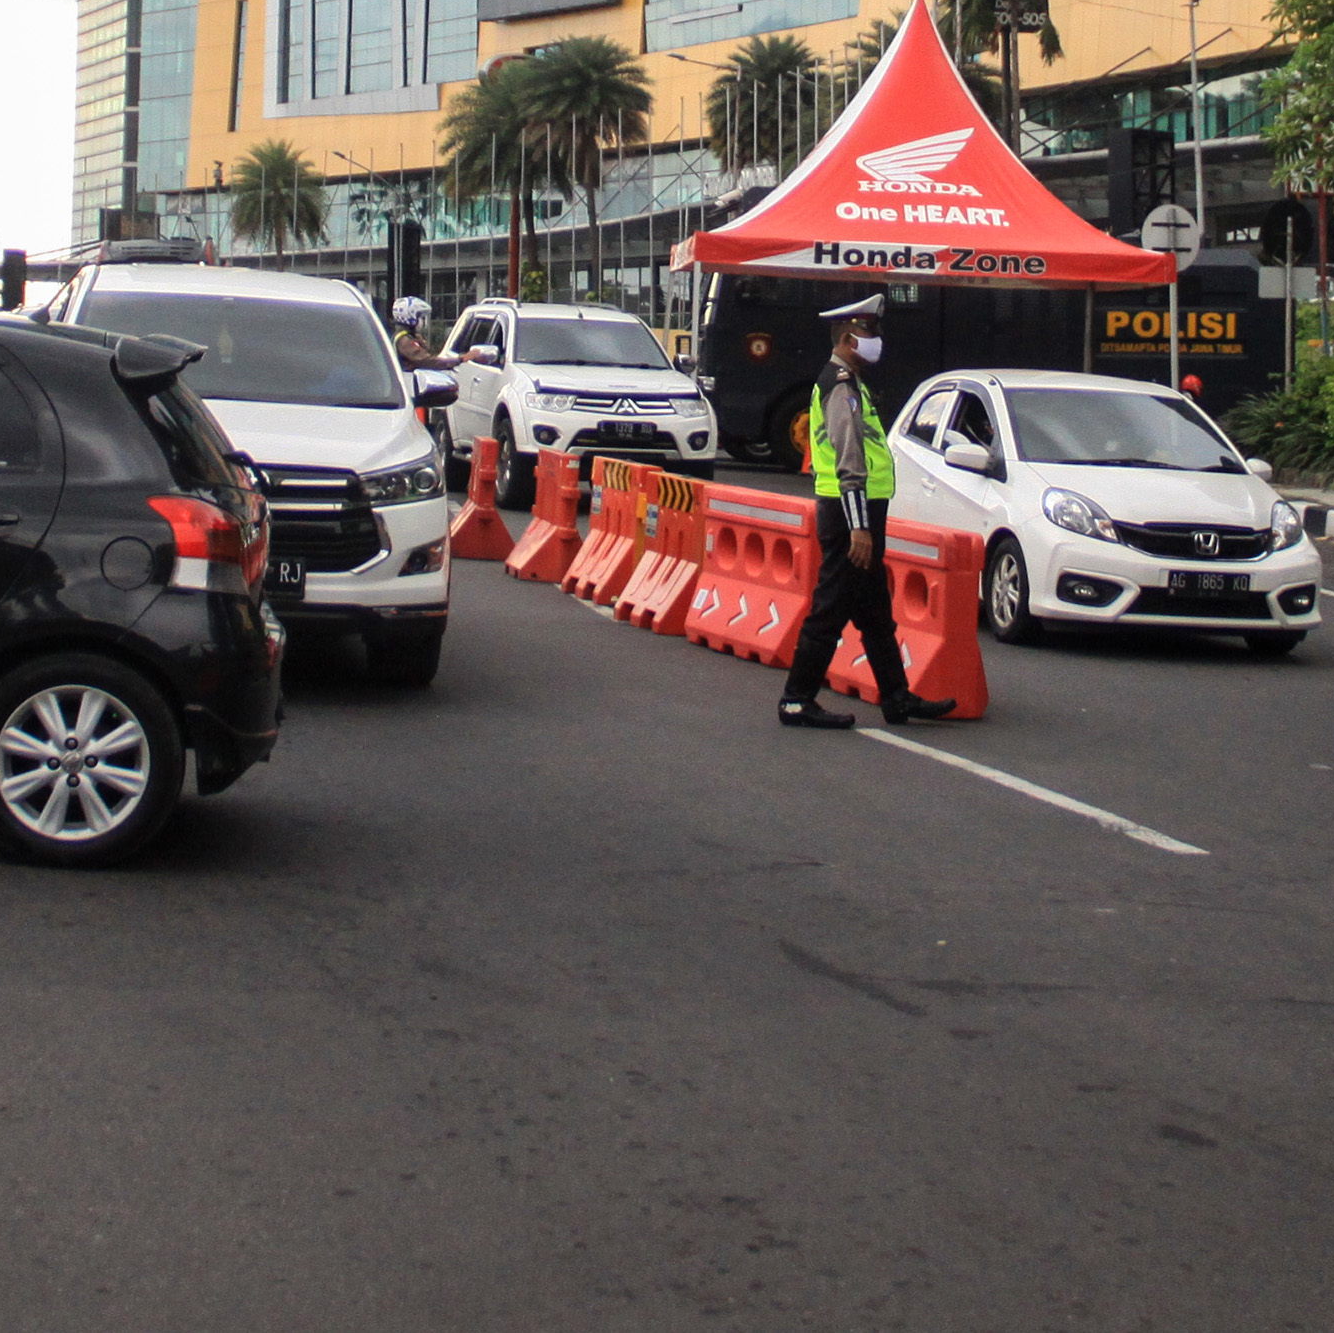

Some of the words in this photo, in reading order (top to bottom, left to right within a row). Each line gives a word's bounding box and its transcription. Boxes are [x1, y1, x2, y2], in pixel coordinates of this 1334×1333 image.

[857, 180, 983, 197] HONDA
[835, 202, 898, 222] One
[903, 204, 1010, 227] HEART.
[814, 241, 937, 271] Honda
[948, 247, 1046, 275] Zone
[1106, 311, 1237, 339] POLISI
[280, 562, 301, 583] RJ
[1171, 573, 1186, 587] AG
[1198, 574, 1225, 590] 1865
